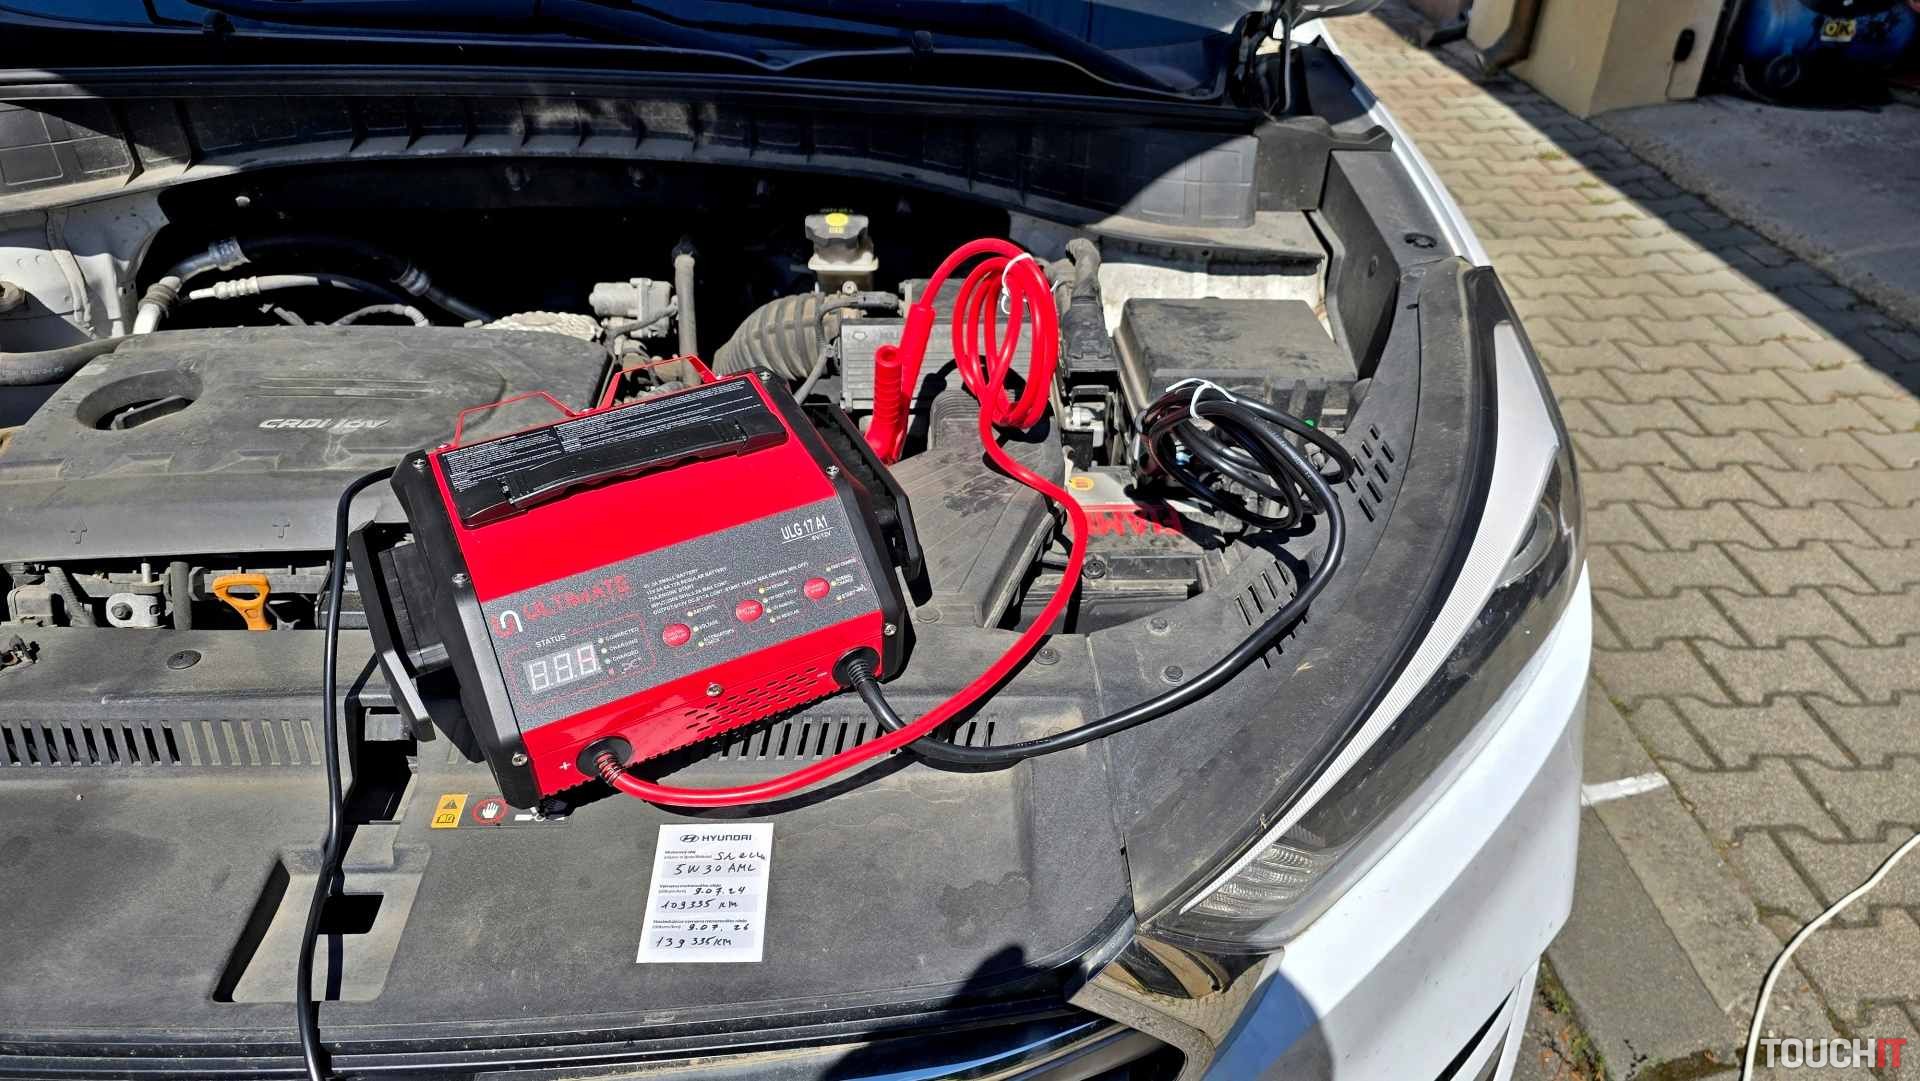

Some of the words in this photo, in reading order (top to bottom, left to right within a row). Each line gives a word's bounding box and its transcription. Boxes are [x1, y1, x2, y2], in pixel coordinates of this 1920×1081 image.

[781, 522, 803, 540] ULG
[803, 519, 815, 533] 17
[816, 515, 828, 529] A1
[523, 575, 628, 621] ULTIMATE
[535, 633, 566, 648] STATUS
[701, 834, 752, 842] HYUNDAI
